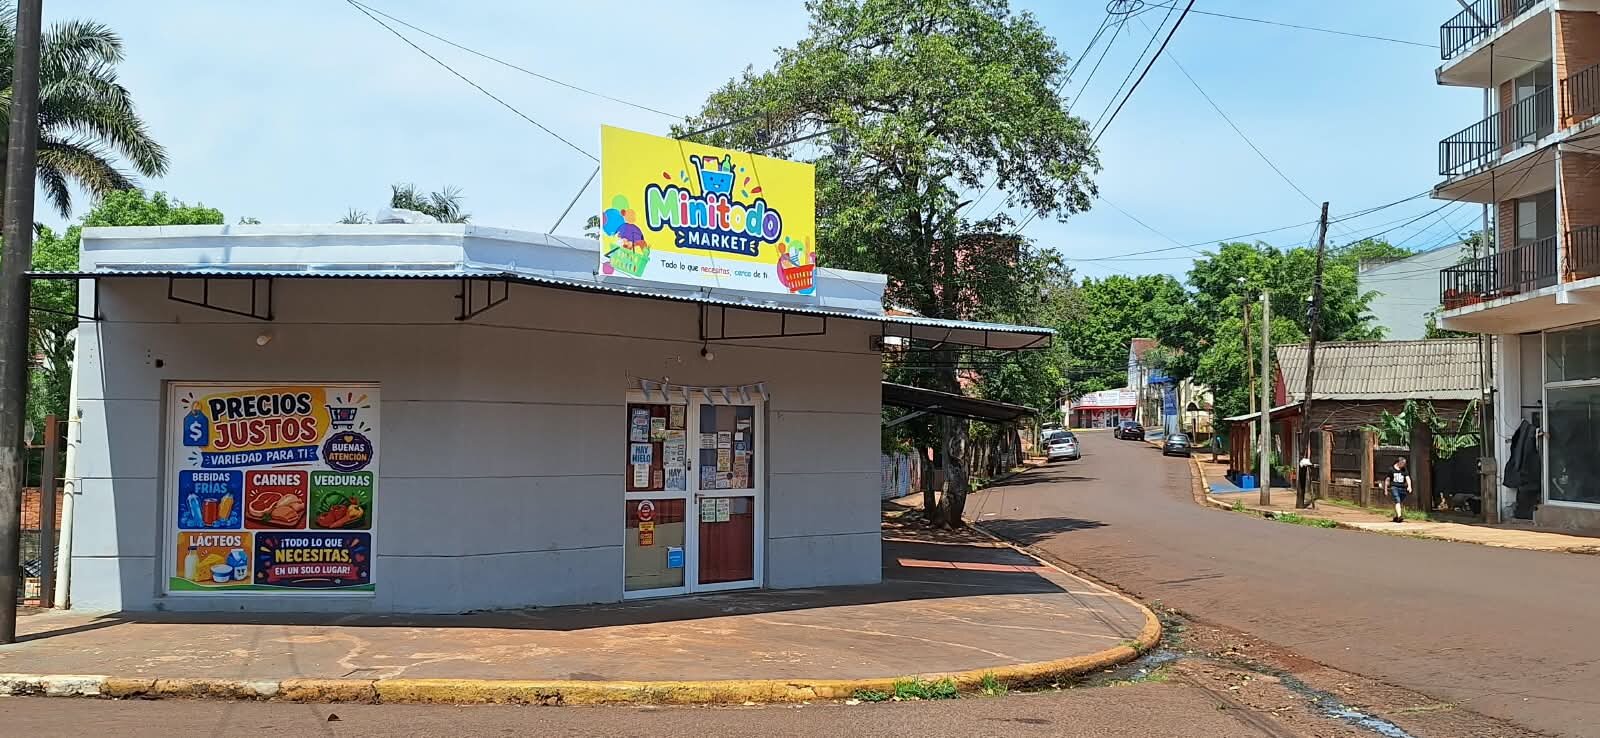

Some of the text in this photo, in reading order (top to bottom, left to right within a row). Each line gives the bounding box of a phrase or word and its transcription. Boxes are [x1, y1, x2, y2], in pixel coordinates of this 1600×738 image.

[648, 187, 780, 240] Minitodo
[688, 231, 747, 251] MARKET
[680, 261, 685, 270] lo
[753, 270, 761, 278] de
[763, 271, 768, 279] ti
[208, 393, 311, 422] PRECIOS
[189, 421, 203, 441] $
[214, 417, 317, 449] JUSTOS
[332, 443, 365, 452] BUENAS
[211, 449, 308, 465] VARIEDAD PARA TI
[329, 451, 367, 461] ATENCIÓN
[192, 473, 230, 482] BEBIDAS
[253, 474, 301, 486] CARNES
[314, 475, 370, 486] VERDURAS
[194, 482, 228, 494] FRÍAS
[189, 533, 241, 547] LÁCTEOS
[281, 538, 343, 548] ¡TODO LO QUE
[275, 549, 352, 564] NECESITAS,
[275, 565, 351, 575] EN UN SOLO LUGAR!
